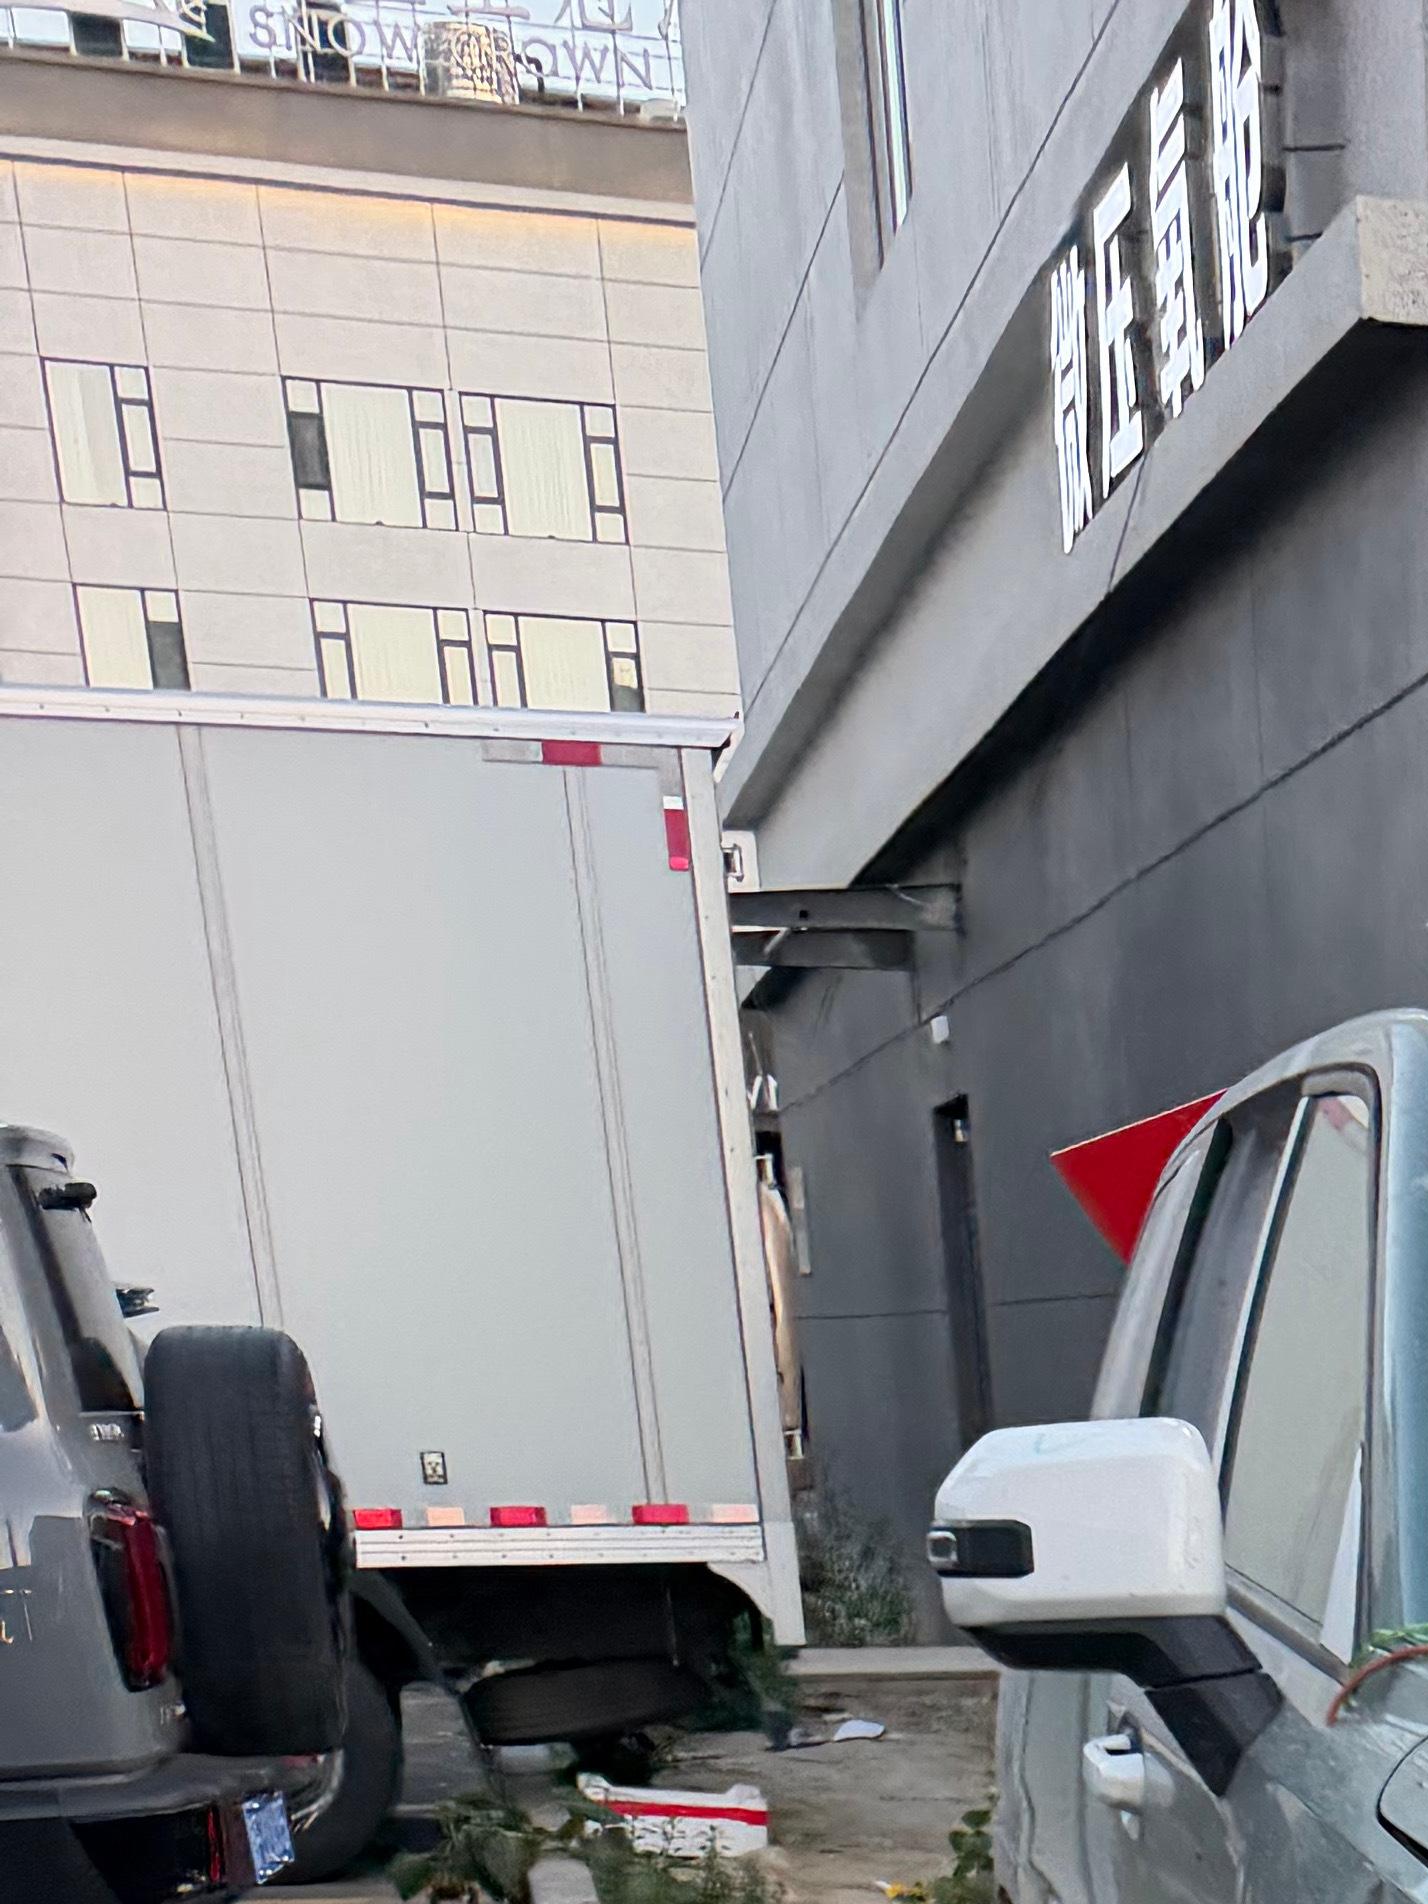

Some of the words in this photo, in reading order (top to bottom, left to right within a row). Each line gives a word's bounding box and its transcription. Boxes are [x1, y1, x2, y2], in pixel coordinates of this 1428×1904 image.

[249, 4, 418, 62] SNOW
[1050, 0, 1268, 554] 微压氧舱
